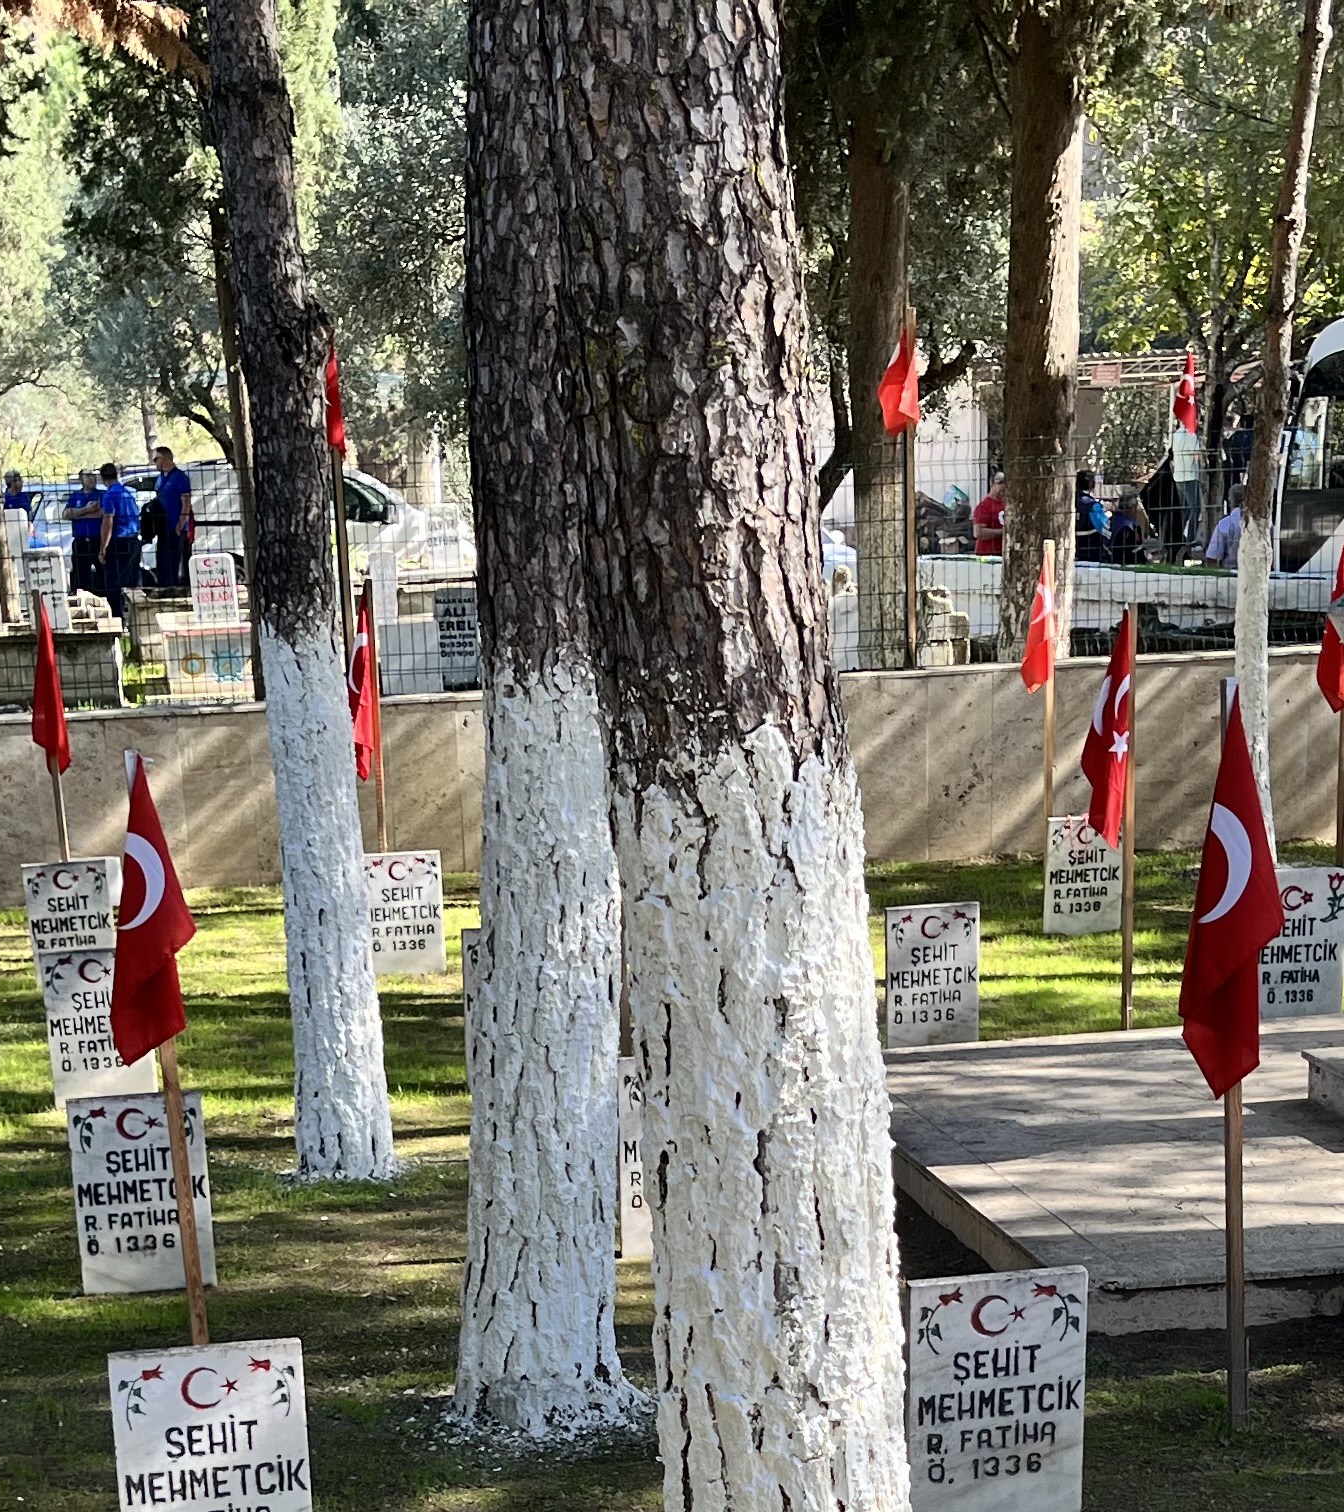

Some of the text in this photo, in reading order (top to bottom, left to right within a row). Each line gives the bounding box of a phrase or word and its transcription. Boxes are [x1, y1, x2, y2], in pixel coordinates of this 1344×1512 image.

[1282, 914, 1317, 937] EHİT
[393, 939, 426, 951] 1336
[1261, 939, 1337, 964] EHMETCİK
[1281, 966, 1320, 984] FATİHA
[72, 987, 111, 1013] ŞEHİ
[1285, 989, 1313, 1003] 1336
[912, 1008, 955, 1024] 1336
[106, 1144, 170, 1177] ŞEHİT
[84, 1215, 103, 1232] R.
[116, 1233, 175, 1253] 1336
[953, 1340, 1041, 1386] ŞEHİT
[918, 1375, 1081, 1426] MEHMETCİK
[165, 1414, 258, 1463] ŞEHİT
[927, 1420, 1056, 1455] R. FATİHA
[125, 1454, 308, 1506] MEHMETCİK
[928, 1452, 1041, 1484] Ö. 1336
